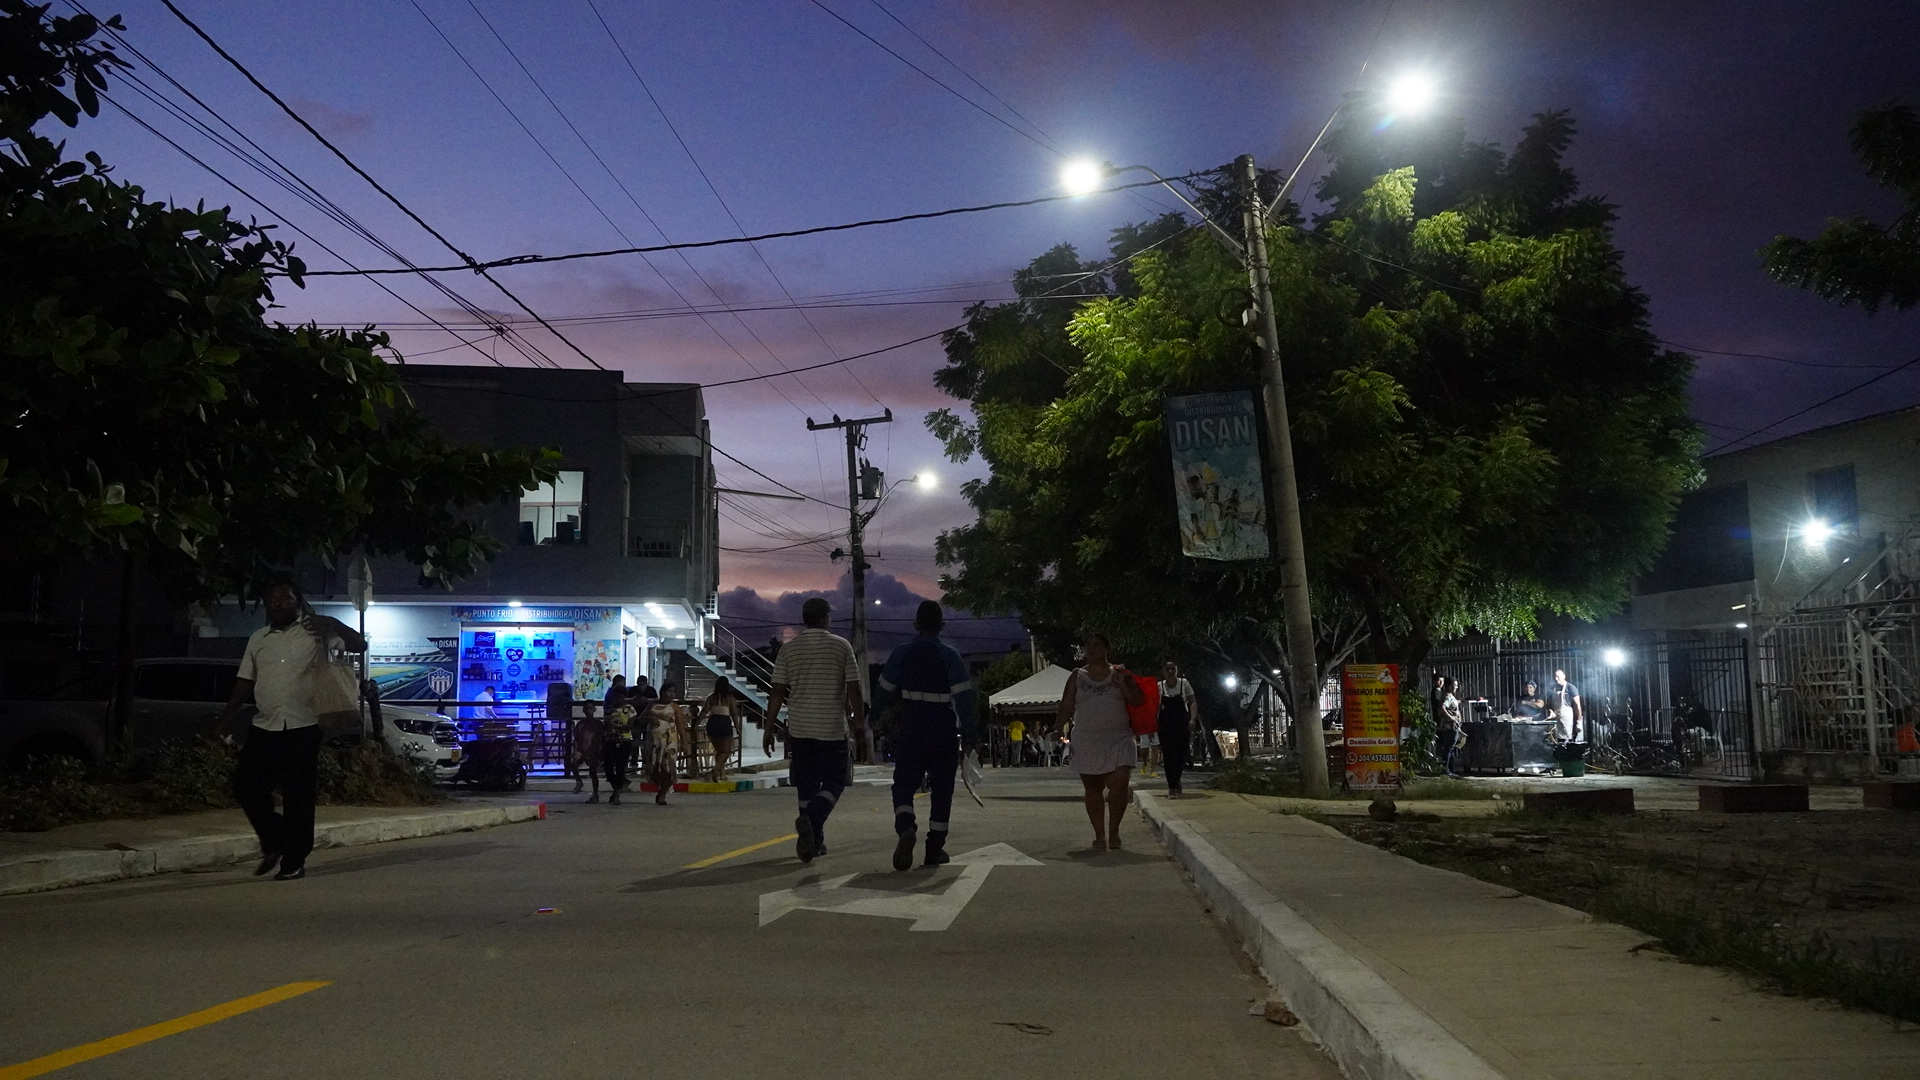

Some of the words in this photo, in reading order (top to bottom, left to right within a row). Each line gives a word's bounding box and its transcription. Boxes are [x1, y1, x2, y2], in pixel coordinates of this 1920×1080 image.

[1185, 396, 1209, 406] PUNTO
[1184, 404, 1238, 416] DISTRIBUIDORA
[1175, 415, 1252, 451] DISAN
[1242, 549, 1265, 558] 6132
[472, 610, 495, 618] PUNTO
[497, 610, 512, 618] FRIO
[521, 609, 573, 618] DISTRIBUIDORA
[574, 608, 602, 620] DISAN
[438, 640, 457, 648] DISAN
[1374, 688, 1390, 696] PARA
[1358, 754, 1370, 762] 304
